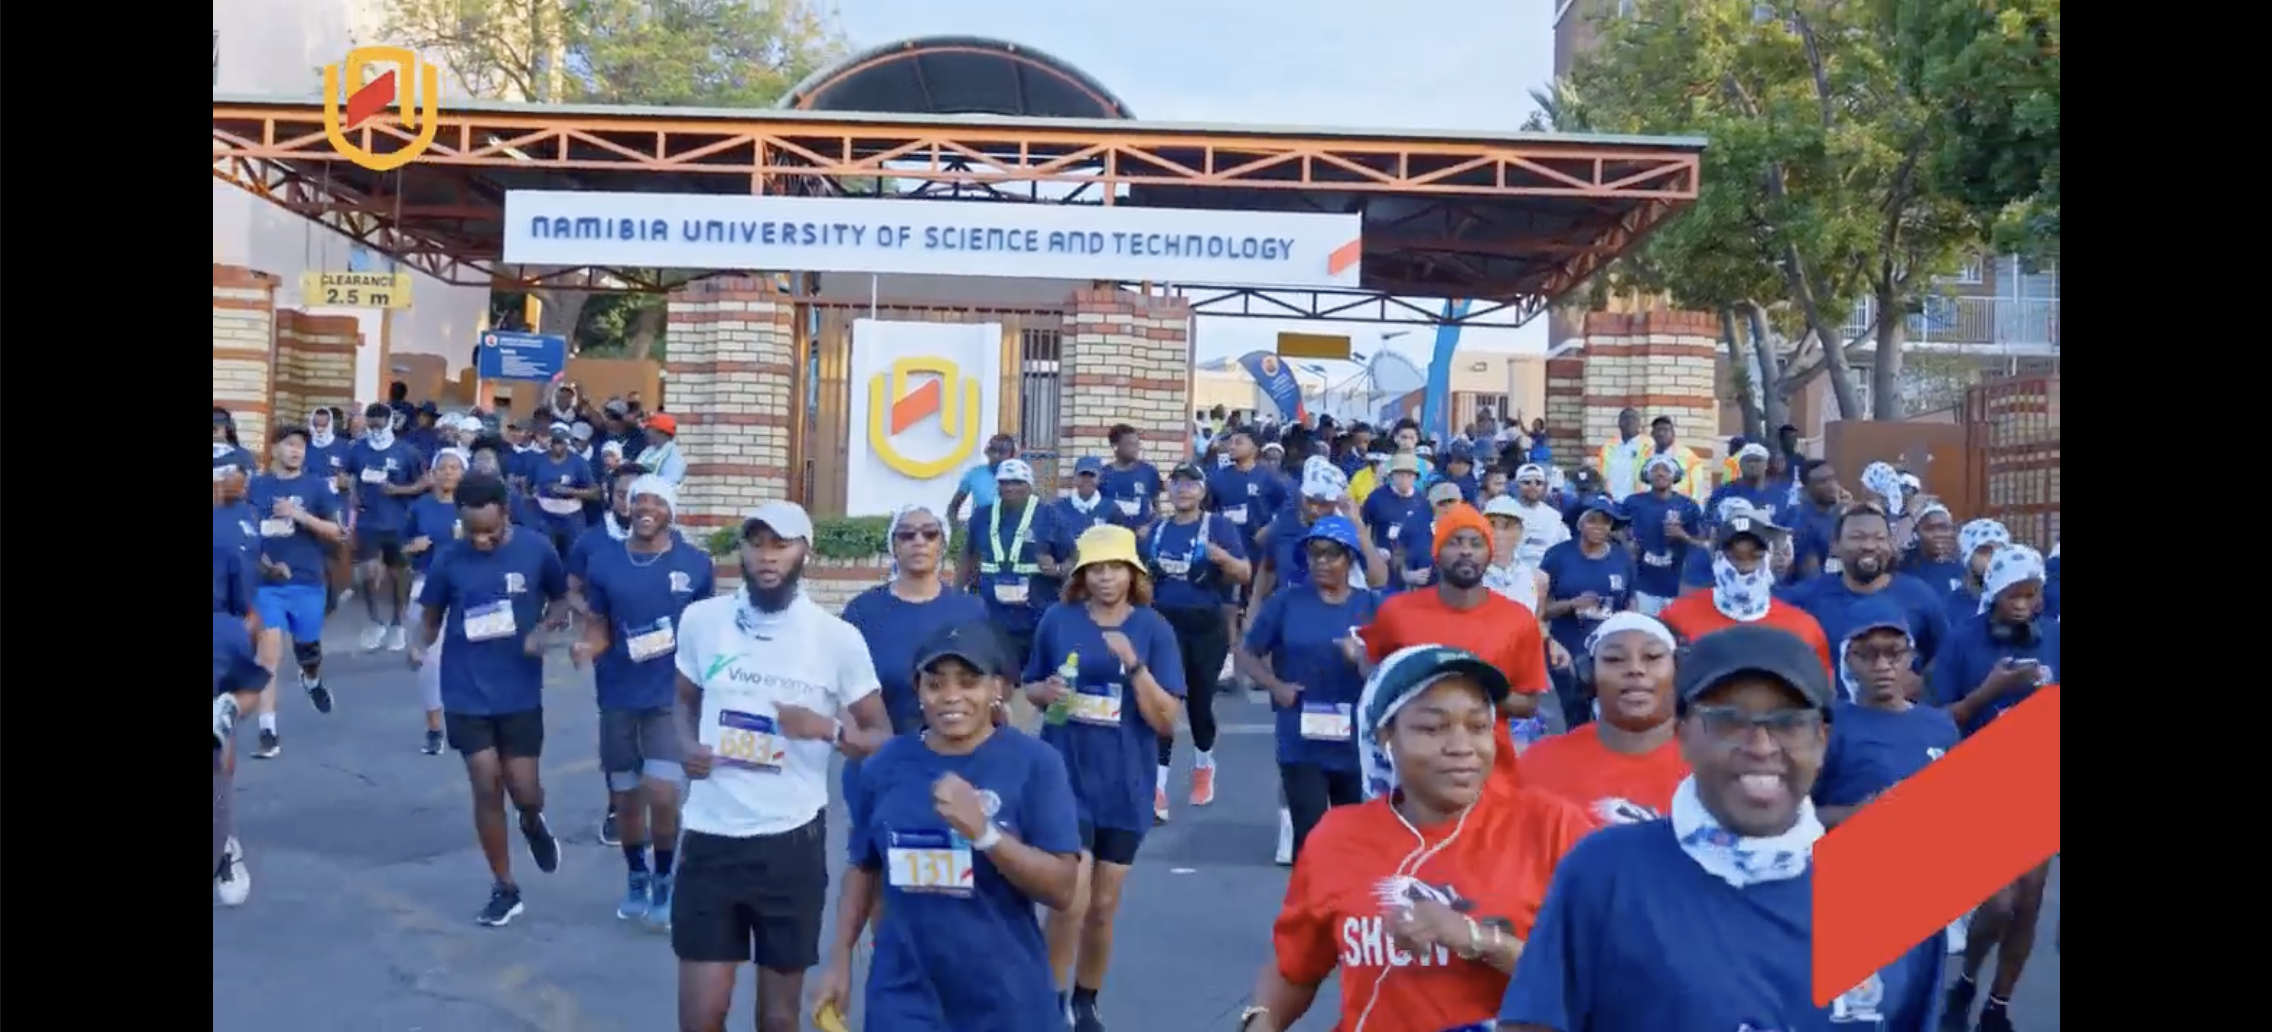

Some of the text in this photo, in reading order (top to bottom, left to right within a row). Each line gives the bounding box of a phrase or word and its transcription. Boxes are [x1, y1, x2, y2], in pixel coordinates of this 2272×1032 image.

[531, 215, 1295, 261] NAMIBIA UNIVERSITY OF SCIENCE AND TECHNOLOGY
[327, 288, 389, 305] 2.5 m
[729, 667, 762, 684] Vivo
